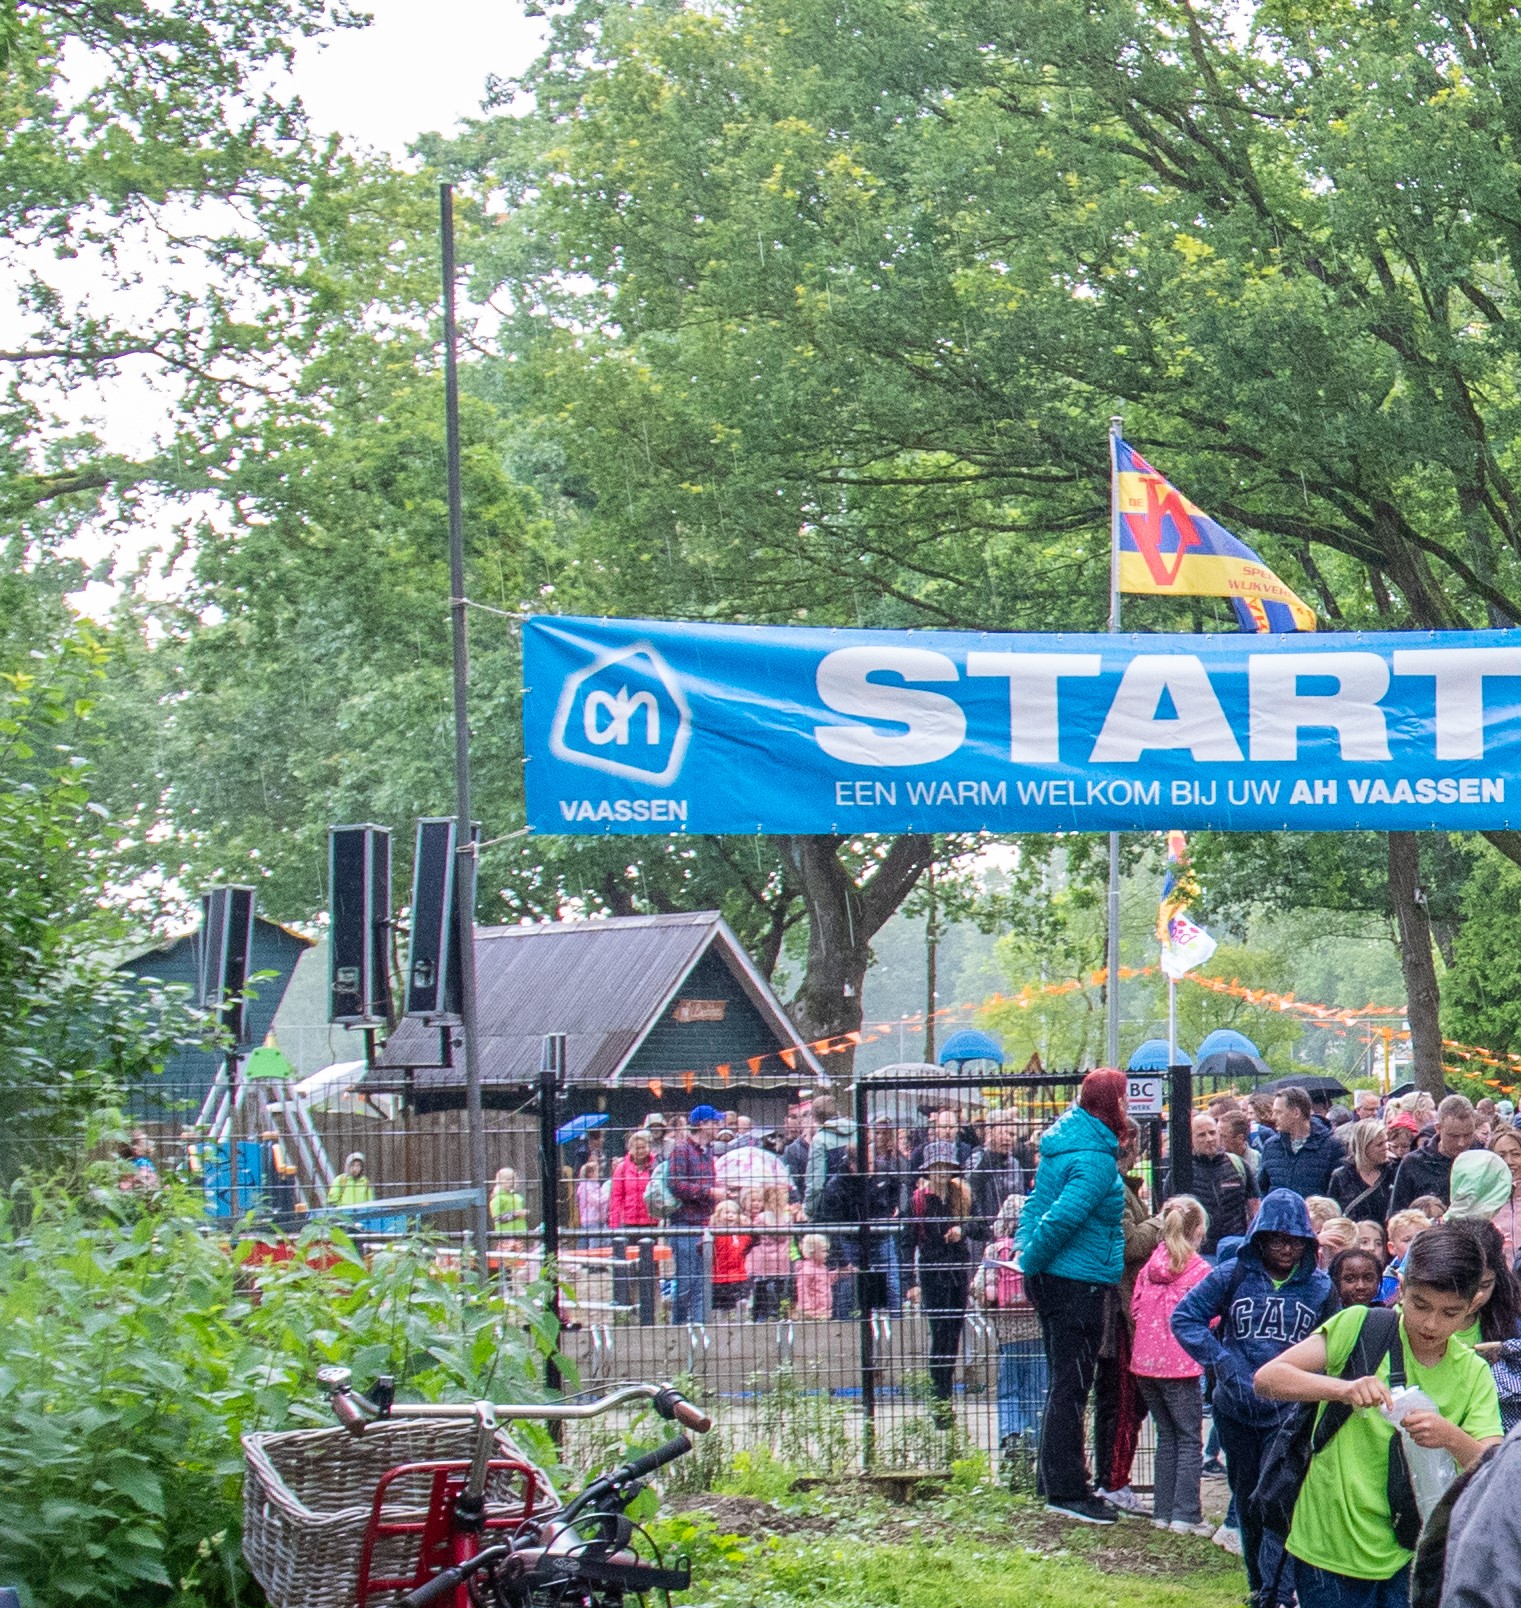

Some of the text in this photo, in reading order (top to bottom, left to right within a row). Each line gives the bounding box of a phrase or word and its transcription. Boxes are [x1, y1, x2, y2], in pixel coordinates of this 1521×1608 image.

[835, 777, 1505, 806] EEN WARM WELKOM BIJ UW AH VAASSEN
[559, 800, 688, 822] VAASSEN
[1127, 1083, 1154, 1097] BC
[1231, 1296, 1318, 1344] GAP
